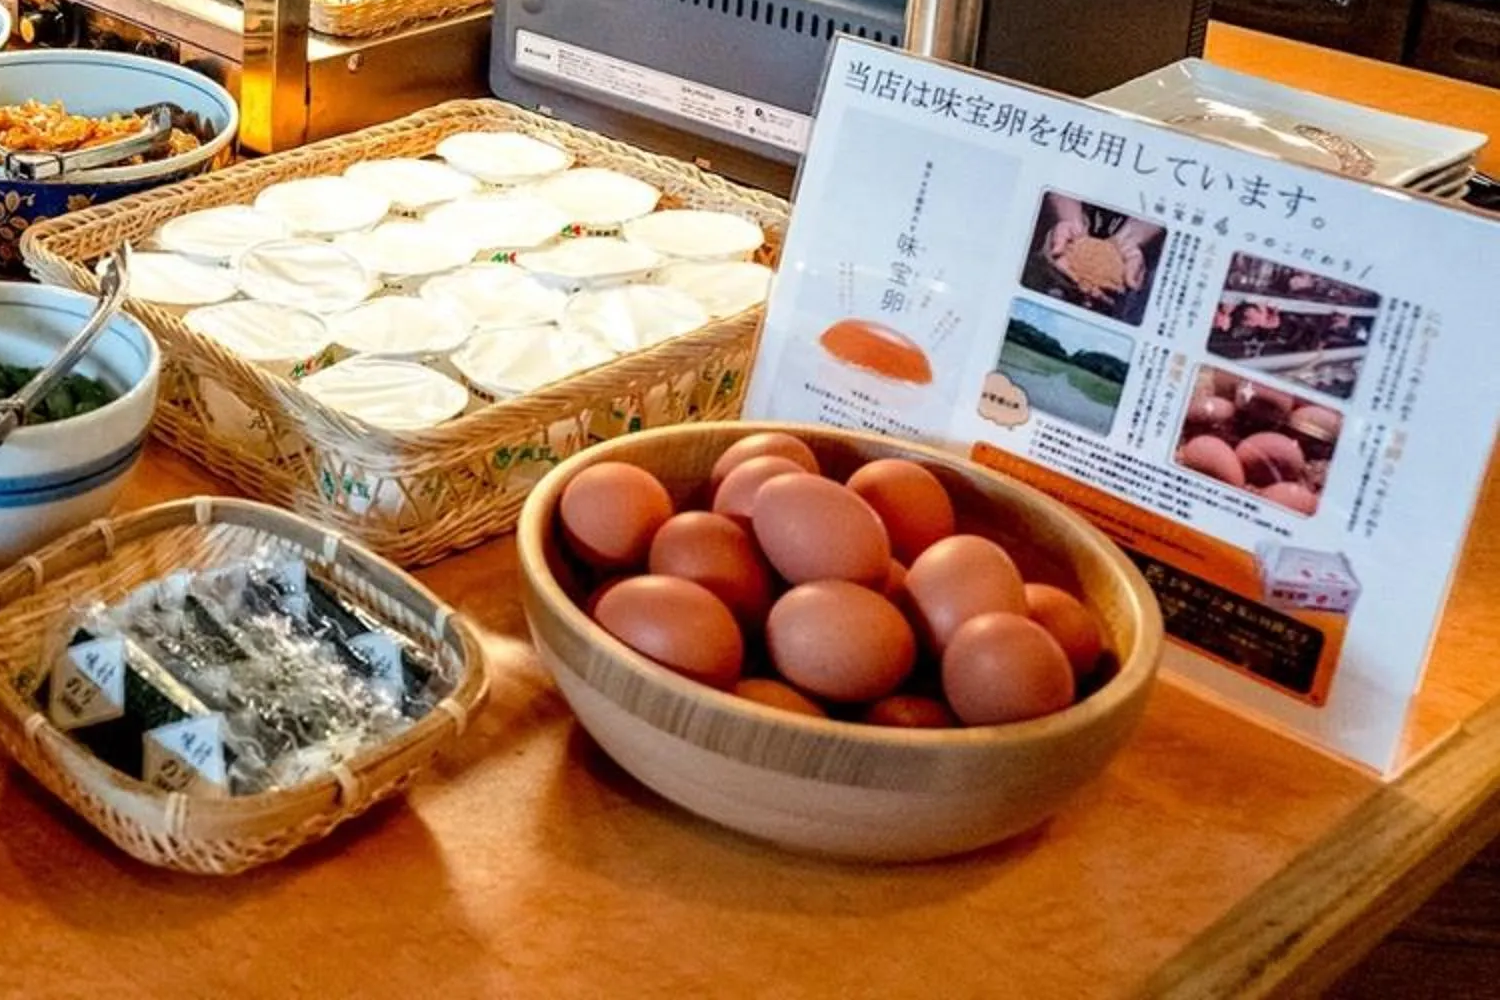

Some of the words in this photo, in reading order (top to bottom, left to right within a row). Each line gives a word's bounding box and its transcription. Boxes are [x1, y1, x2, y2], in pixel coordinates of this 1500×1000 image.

[844, 60, 1327, 230] 当店は味宝卵を使用しています。
[880, 233, 920, 314] 味宝卵
